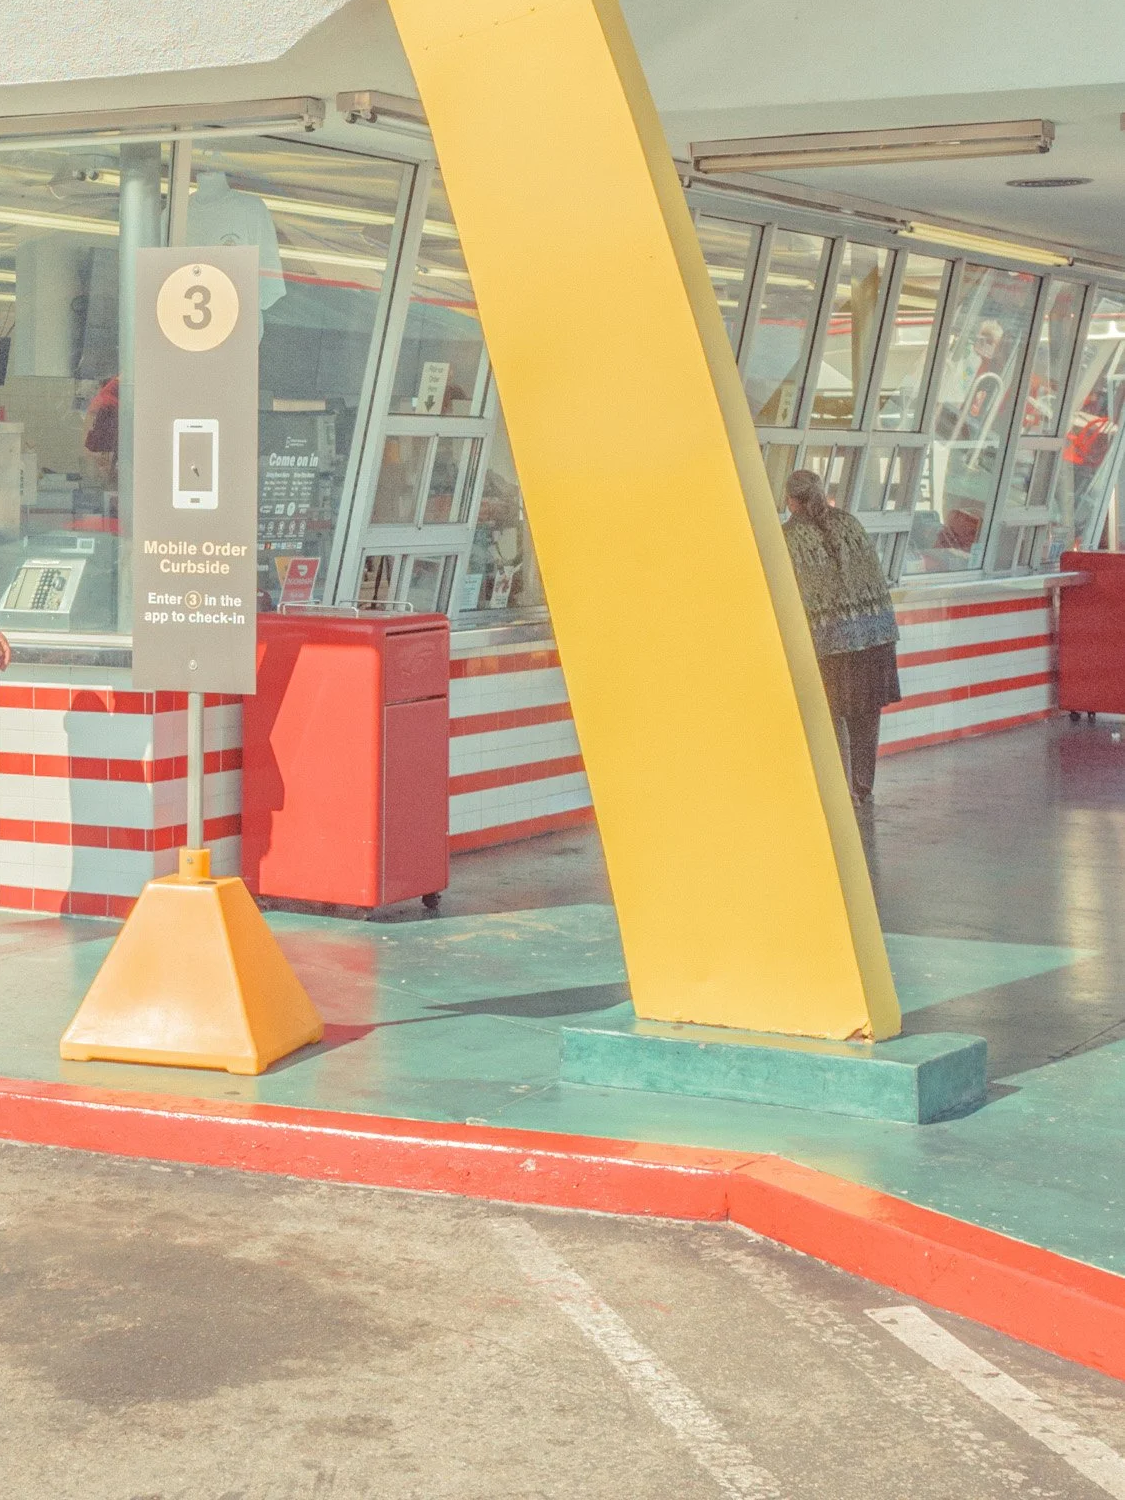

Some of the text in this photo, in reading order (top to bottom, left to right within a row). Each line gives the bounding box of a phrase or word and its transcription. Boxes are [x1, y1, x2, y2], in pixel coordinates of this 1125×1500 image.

[183, 284, 212, 331] 3
[269, 452, 319, 467] Come on in
[144, 540, 248, 556] Mobile Order
[159, 558, 230, 575] Curbside
[148, 592, 183, 605] Enter
[204, 594, 216, 606] in
[220, 594, 242, 607] the
[144, 611, 245, 624] app to check-in
